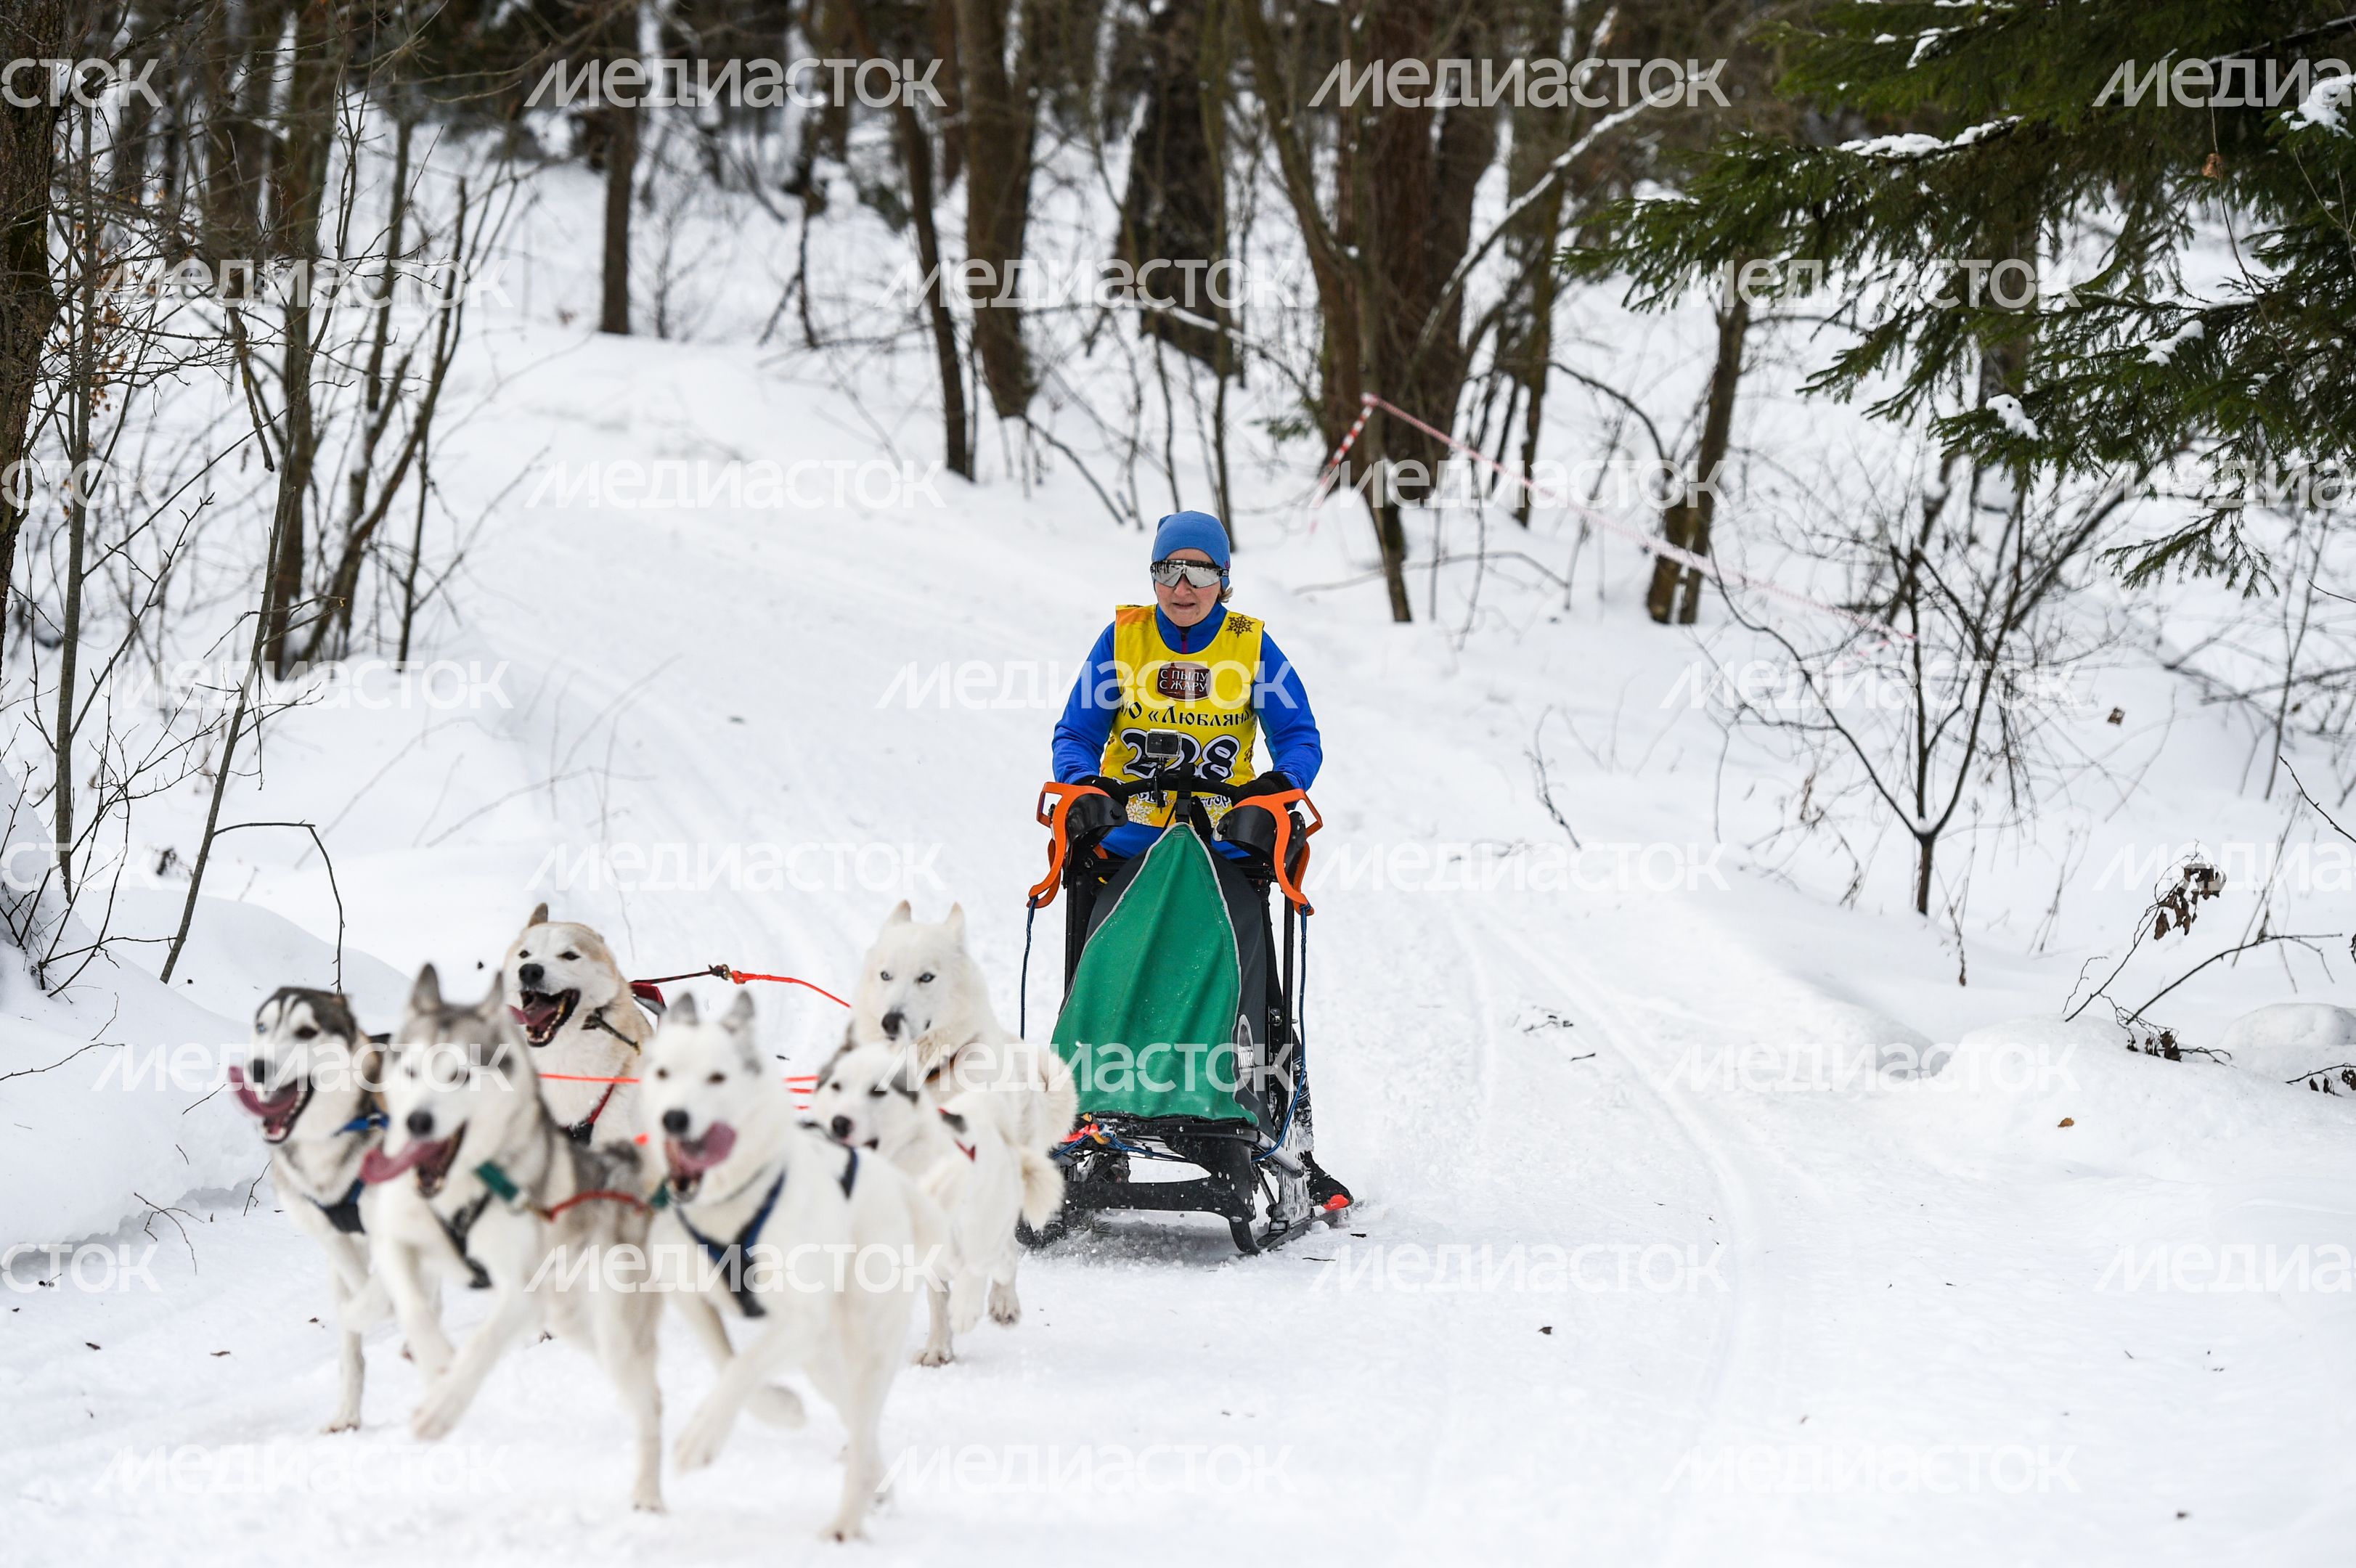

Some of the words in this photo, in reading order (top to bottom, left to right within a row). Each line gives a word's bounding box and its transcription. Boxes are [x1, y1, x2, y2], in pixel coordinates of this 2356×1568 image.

[1159, 669, 1168, 679] С
[1172, 670, 1208, 682] ПЫЛУ
[1159, 679, 1167, 690] С
[1170, 680, 1207, 692] ЖАРУ
